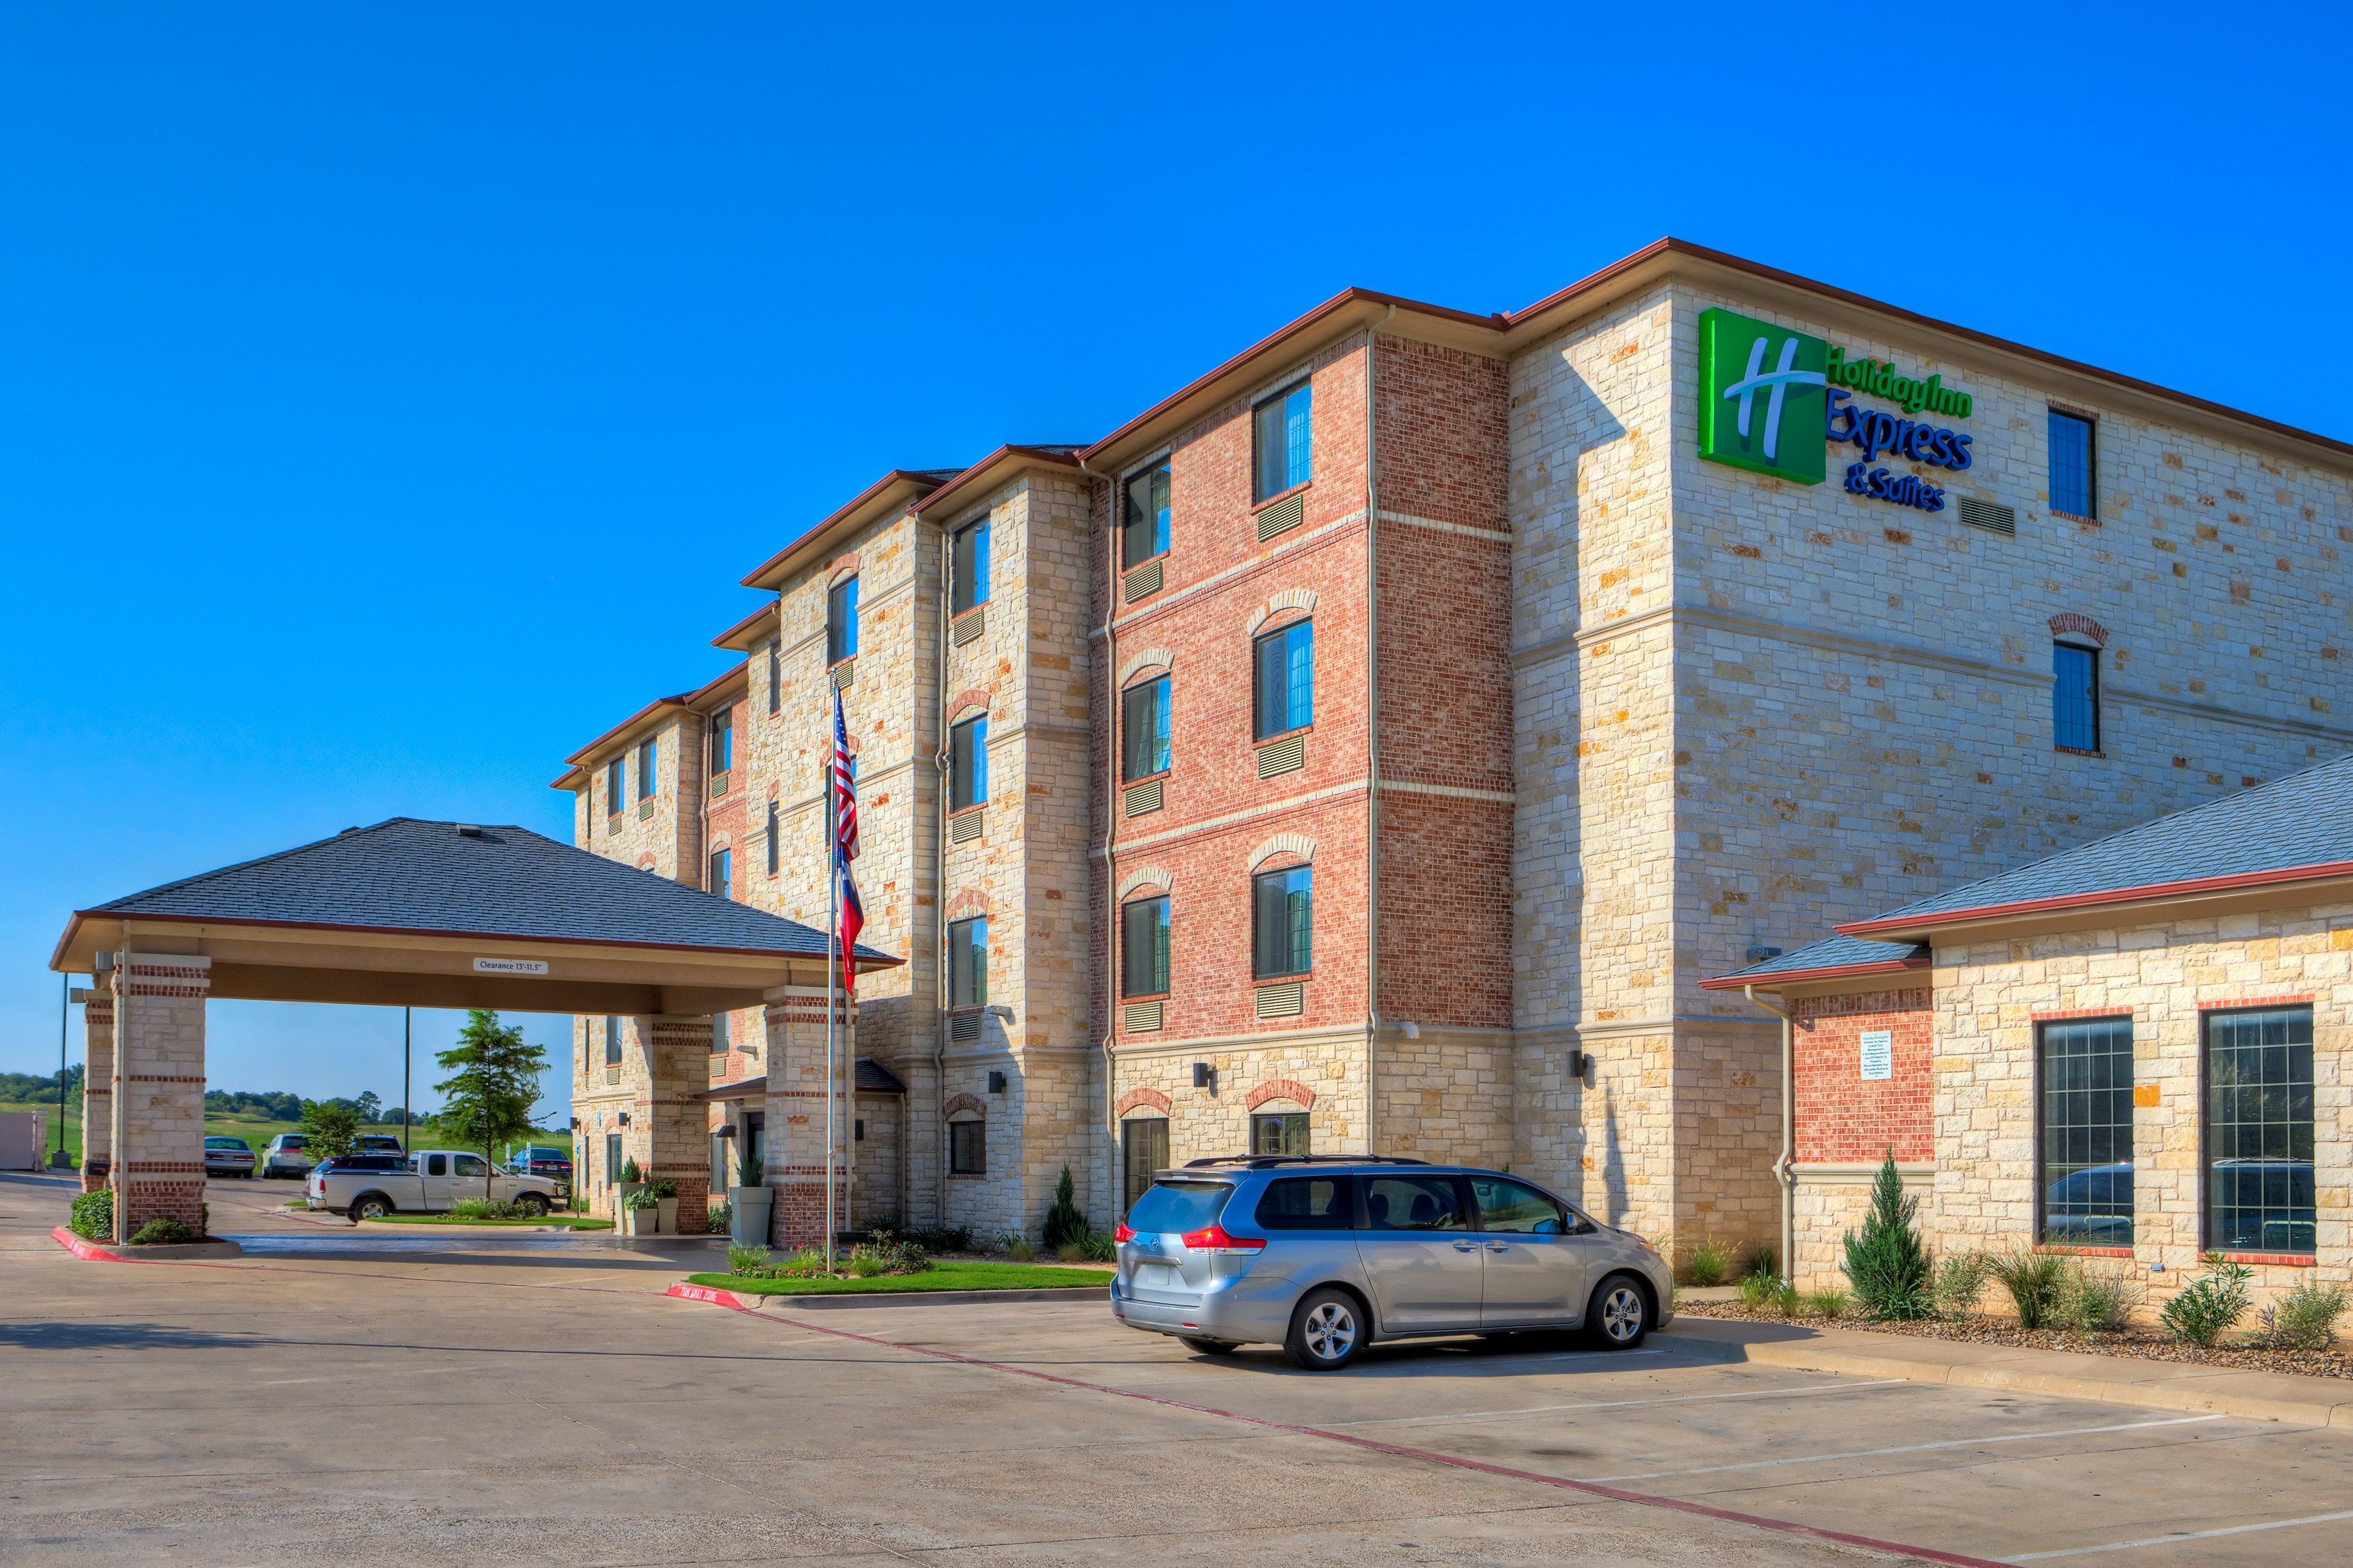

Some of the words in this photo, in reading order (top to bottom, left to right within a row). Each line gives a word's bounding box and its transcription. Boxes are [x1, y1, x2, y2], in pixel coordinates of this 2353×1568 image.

[1826, 388, 1973, 471] Express
[1866, 468, 1945, 512] Suites
[480, 961, 514, 970] Clearance
